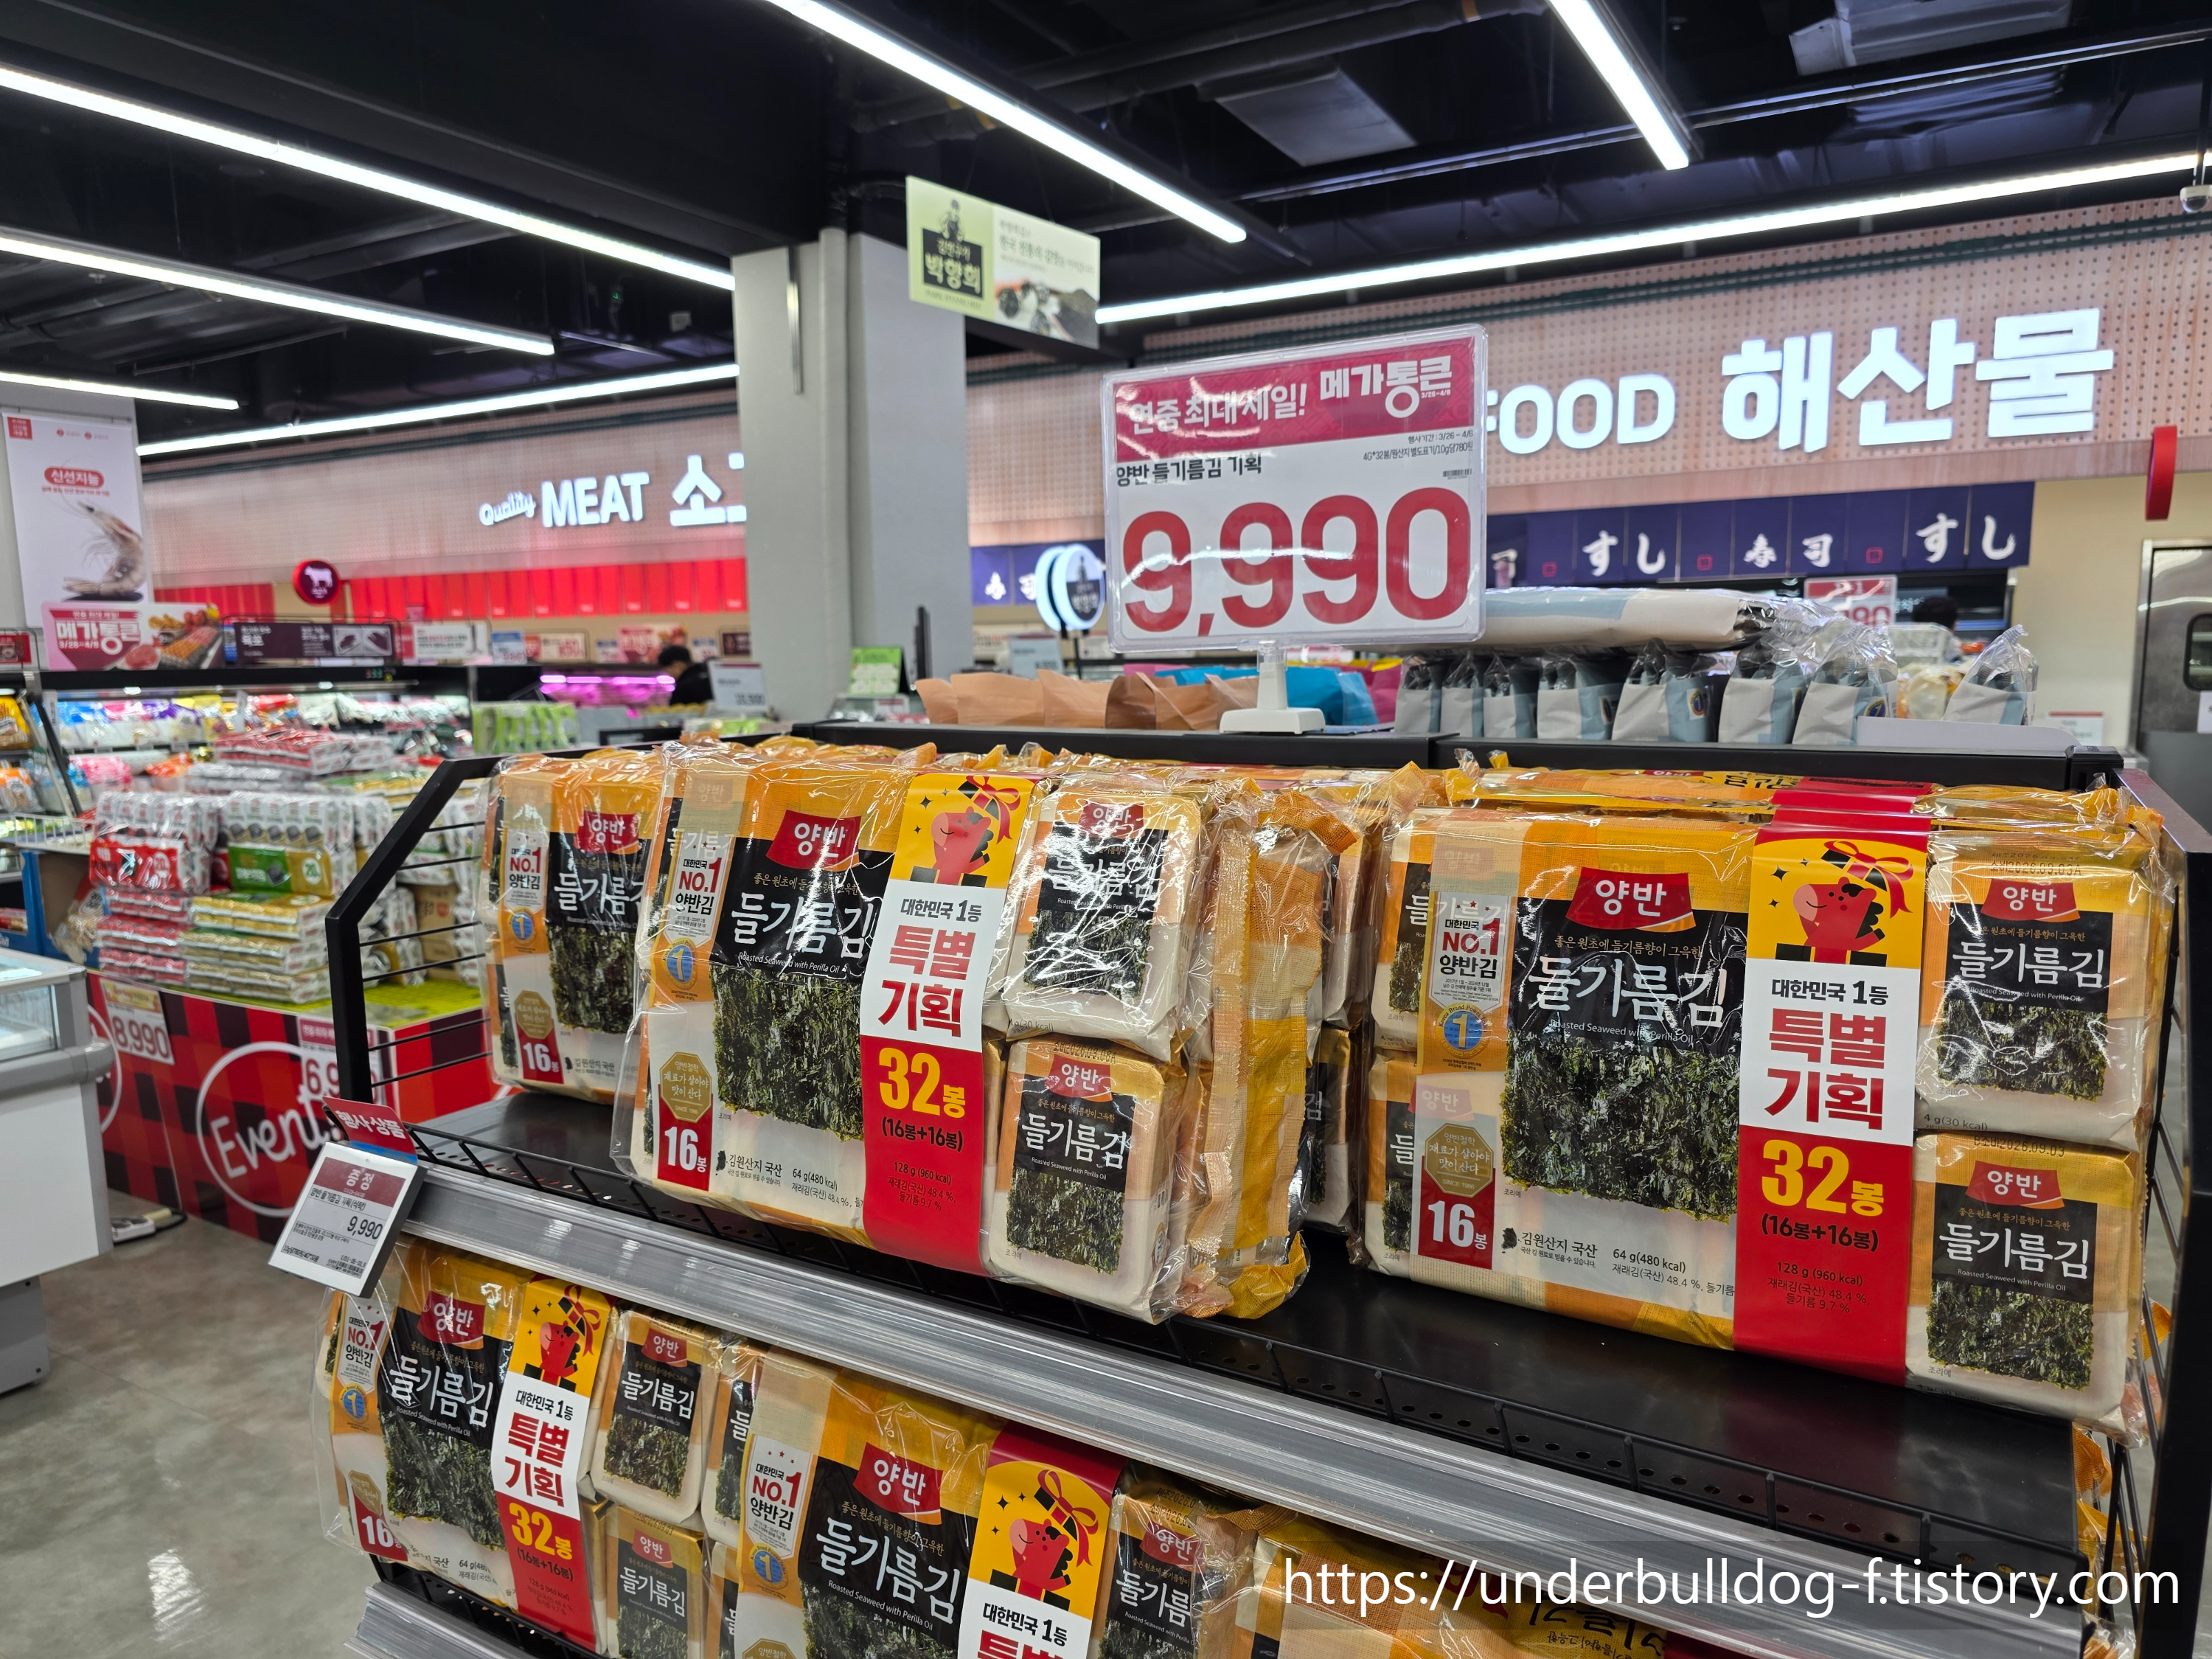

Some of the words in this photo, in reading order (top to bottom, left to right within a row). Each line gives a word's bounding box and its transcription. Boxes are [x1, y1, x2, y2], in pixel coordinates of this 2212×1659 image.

[925, 252, 981, 293] 박향희
[1321, 355, 1452, 419] 메가통큰
[1722, 308, 2114, 453] 해산물
[1185, 391, 1237, 428] 최대
[1242, 384, 1307, 422] 세일!
[1408, 434, 1434, 444] 행사기간
[1439, 432, 1454, 440] 3/26
[51, 469, 100, 485] 신선지능
[1116, 463, 1150, 487] 양반
[1152, 458, 1222, 483] 들기름김
[1230, 453, 1262, 476] 기획
[479, 491, 536, 526] Quality
[541, 472, 650, 528] MEAT
[1582, 529, 1666, 577] すし
[1916, 512, 2016, 563] すし
[1123, 487, 1471, 636] 9,990
[55, 621, 141, 655] 메가통큰
[590, 818, 625, 845] 양반
[1093, 807, 1131, 830] 양반
[794, 822, 846, 858] 양반
[509, 847, 541, 874] NO.1
[678, 857, 723, 894] NO.1
[509, 874, 540, 891] 양반김
[1048, 856, 1157, 899] 들기름김
[675, 893, 714, 915] 양반김
[900, 898, 953, 920] 대한민국
[956, 900, 982, 922] 1등
[1596, 880, 1666, 917] 양반
[2003, 887, 2057, 912] 양반
[731, 892, 882, 959] 들기름김
[1442, 918, 1500, 956] NO.1
[1445, 919, 1480, 930] 대한민국
[1992, 927, 2015, 938] 원초에
[2017, 928, 2058, 940] 들기름향이
[2059, 931, 2085, 942] 그윽한
[739, 952, 763, 964] Roasted
[764, 954, 793, 968] Seaweed
[794, 958, 807, 969] with
[809, 960, 829, 973] Perilla
[830, 964, 840, 973] Oil
[889, 925, 976, 980] 특별
[1554, 935, 1576, 950] 좋은
[1578, 936, 1610, 952] 원초에
[1611, 939, 1666, 957] 들기름향이
[1668, 945, 1701, 959] 그윽한
[1440, 954, 1498, 979] 양반김
[1952, 941, 2105, 989] 들기름김
[878, 979, 964, 1038] 기획
[1528, 956, 1728, 1028] 들기름김
[1772, 979, 1846, 1002] 대한민국
[1852, 981, 1888, 1006] 1등
[113, 1015, 170, 1060] 8,990
[1769, 1008, 1887, 1069] 특별
[524, 1043, 560, 1072] 16봉
[663, 1071, 687, 1085] 재료가
[688, 1074, 709, 1090] 살아야
[878, 1047, 966, 1119] 32봉
[1061, 1063, 1099, 1092] 양반
[1422, 1089, 1458, 1113] 양반
[1764, 1068, 1884, 1130] 기획
[335, 1110, 407, 1139] 행사상품
[882, 1116, 963, 1152] (16봉+16봉)
[1444, 1133, 1475, 1144] 양반철학
[664, 1126, 707, 1173] 16봉
[1022, 1113, 1127, 1170] 들기름김
[1429, 1143, 1458, 1158] 재료가
[1461, 1148, 1489, 1164] 살아야
[346, 1168, 375, 1191] 증정
[728, 1154, 762, 1173] 김원산지
[765, 1163, 782, 1178] 국산
[793, 1168, 803, 1179] 64
[803, 1171, 824, 1185] g(480
[824, 1176, 838, 1192] kcal)
[1439, 1158, 1457, 1172] 맛이
[1459, 1162, 1479, 1175] 산다
[1761, 1139, 1884, 1217] 32봉
[1503, 1188, 1521, 1198] 조리예
[1987, 1170, 2041, 1199] 양반
[347, 1216, 383, 1239] 9,990
[1427, 1200, 1488, 1250] 16봉
[1761, 1213, 1879, 1253] (16봉+16봉)
[1958, 1207, 1975, 1218] 좋은
[1976, 1209, 2000, 1222] 원초에
[2002, 1213, 2043, 1228] 들기름향이
[2045, 1219, 2070, 1231] 그윽한
[1521, 1232, 1567, 1253] 김원산지
[1571, 1241, 1598, 1259] 국산
[1613, 1248, 1627, 1259] 64
[1630, 1251, 1660, 1267] g(480
[1662, 1257, 1686, 1274] kcal)
[1939, 1222, 2089, 1279] 들기름김
[1777, 1262, 1798, 1275] 128
[1801, 1267, 1809, 1278] g
[1812, 1267, 1836, 1282] (960
[1839, 1272, 1863, 1287] kcal)
[1958, 1268, 1984, 1280] Roasted
[1986, 1272, 2016, 1284] Seaweed
[2017, 1278, 2032, 1287] with
[2034, 1279, 2055, 1290] Perilla
[2056, 1284, 2066, 1292] Oil
[434, 1303, 473, 1337] 양반
[1785, 1293, 1816, 1309] 들기름
[1819, 1299, 1836, 1311] 9.7
[1839, 1303, 1850, 1314] %
[348, 1320, 385, 1352] NO.1
[653, 1335, 679, 1358] 양반
[346, 1344, 374, 1368] 양반김
[1927, 1366, 1952, 1377] 조리예
[389, 1354, 493, 1428] 들기름김
[515, 1390, 554, 1414] 대한민국
[555, 1399, 574, 1422] 1등
[621, 1371, 695, 1419] 들기름김
[508, 1412, 570, 1469] 특별
[504, 1456, 565, 1508] 기획
[756, 1463, 785, 1480] 대한민국
[874, 1458, 927, 1506] 양반
[752, 1472, 802, 1509] NO.1
[750, 1498, 795, 1531] 양반김
[509, 1503, 573, 1560] 32봉
[640, 1536, 664, 1559] 양반
[1156, 1529, 1193, 1561] 양반
[517, 1546, 574, 1582] (16봉+16봉)
[816, 1517, 960, 1624] 들기름김
[620, 1566, 685, 1618] 들기름김
[828, 1579, 854, 1598] Roasted
[855, 1590, 886, 1610] Seaweed
[886, 1604, 902, 1616] with
[902, 1610, 924, 1626] Perilla
[924, 1621, 933, 1632] Oil
[982, 1602, 1039, 1635] 대한민국
[1042, 1618, 1068, 1647] 1등
